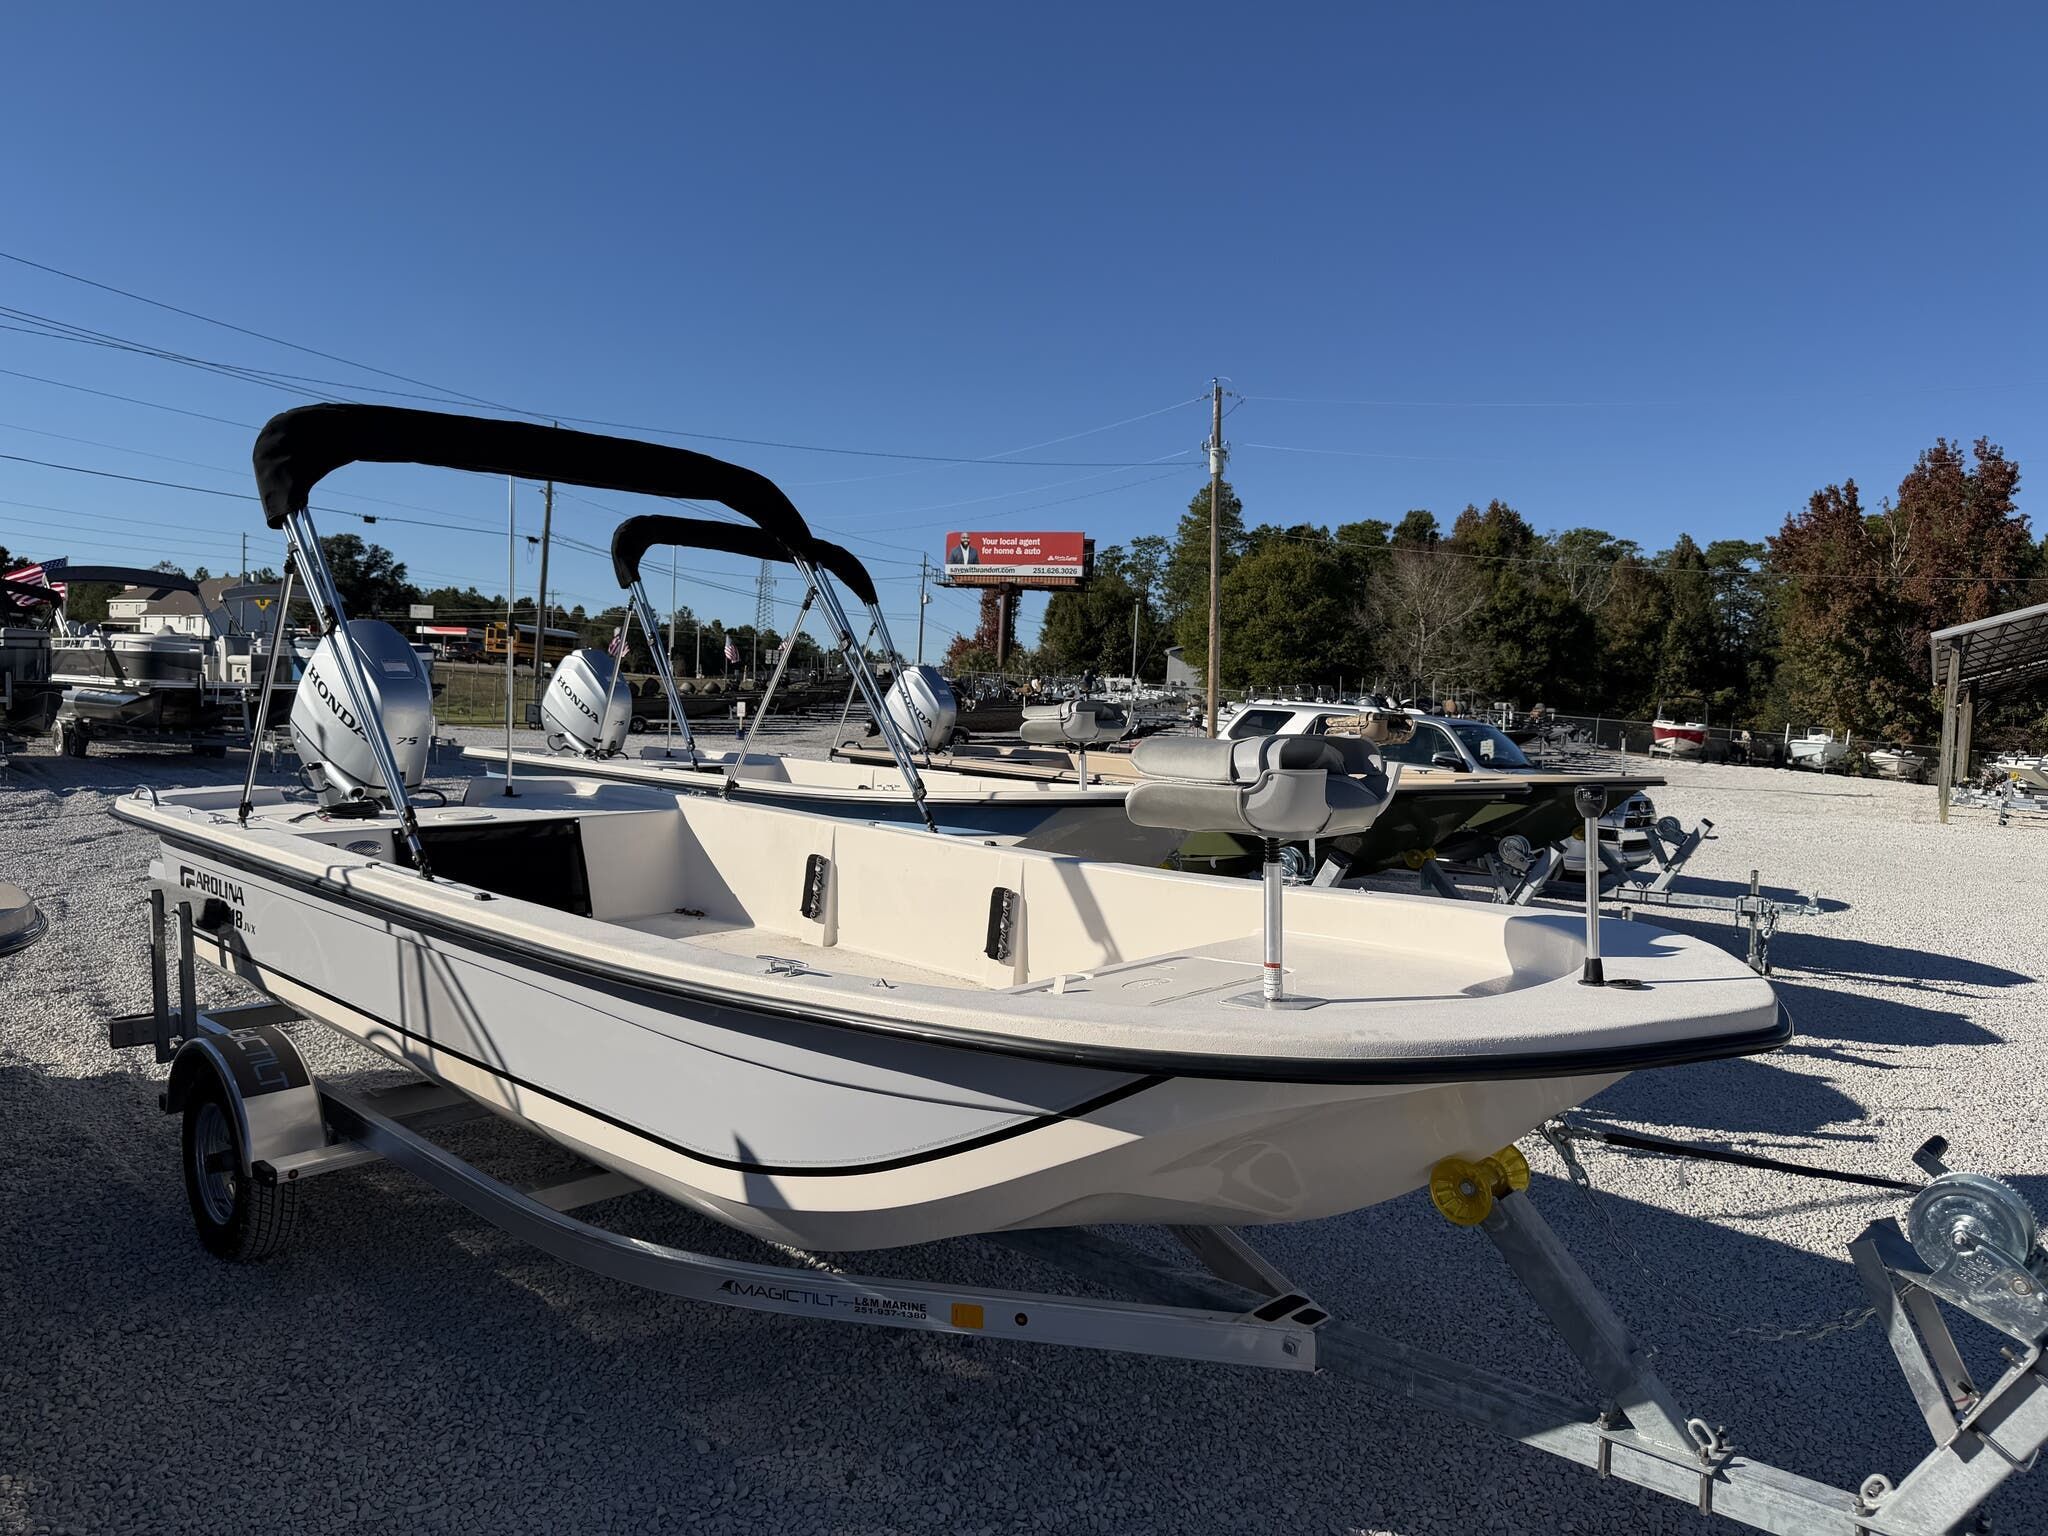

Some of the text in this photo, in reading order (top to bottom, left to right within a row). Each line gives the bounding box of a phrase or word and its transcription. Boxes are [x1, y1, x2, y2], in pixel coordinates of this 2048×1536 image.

[1019, 538, 1040, 547] agent
[982, 547, 1041, 555] for home & auto
[1032, 567, 1078, 575] 251.626.3026
[557, 676, 600, 725] HONDA
[396, 736, 418, 745] 75
[734, 1281, 839, 1308] MAGICTILT
[854, 1296, 927, 1313] L&M MARINE
[854, 1305, 927, 1320] 251-937-1380
